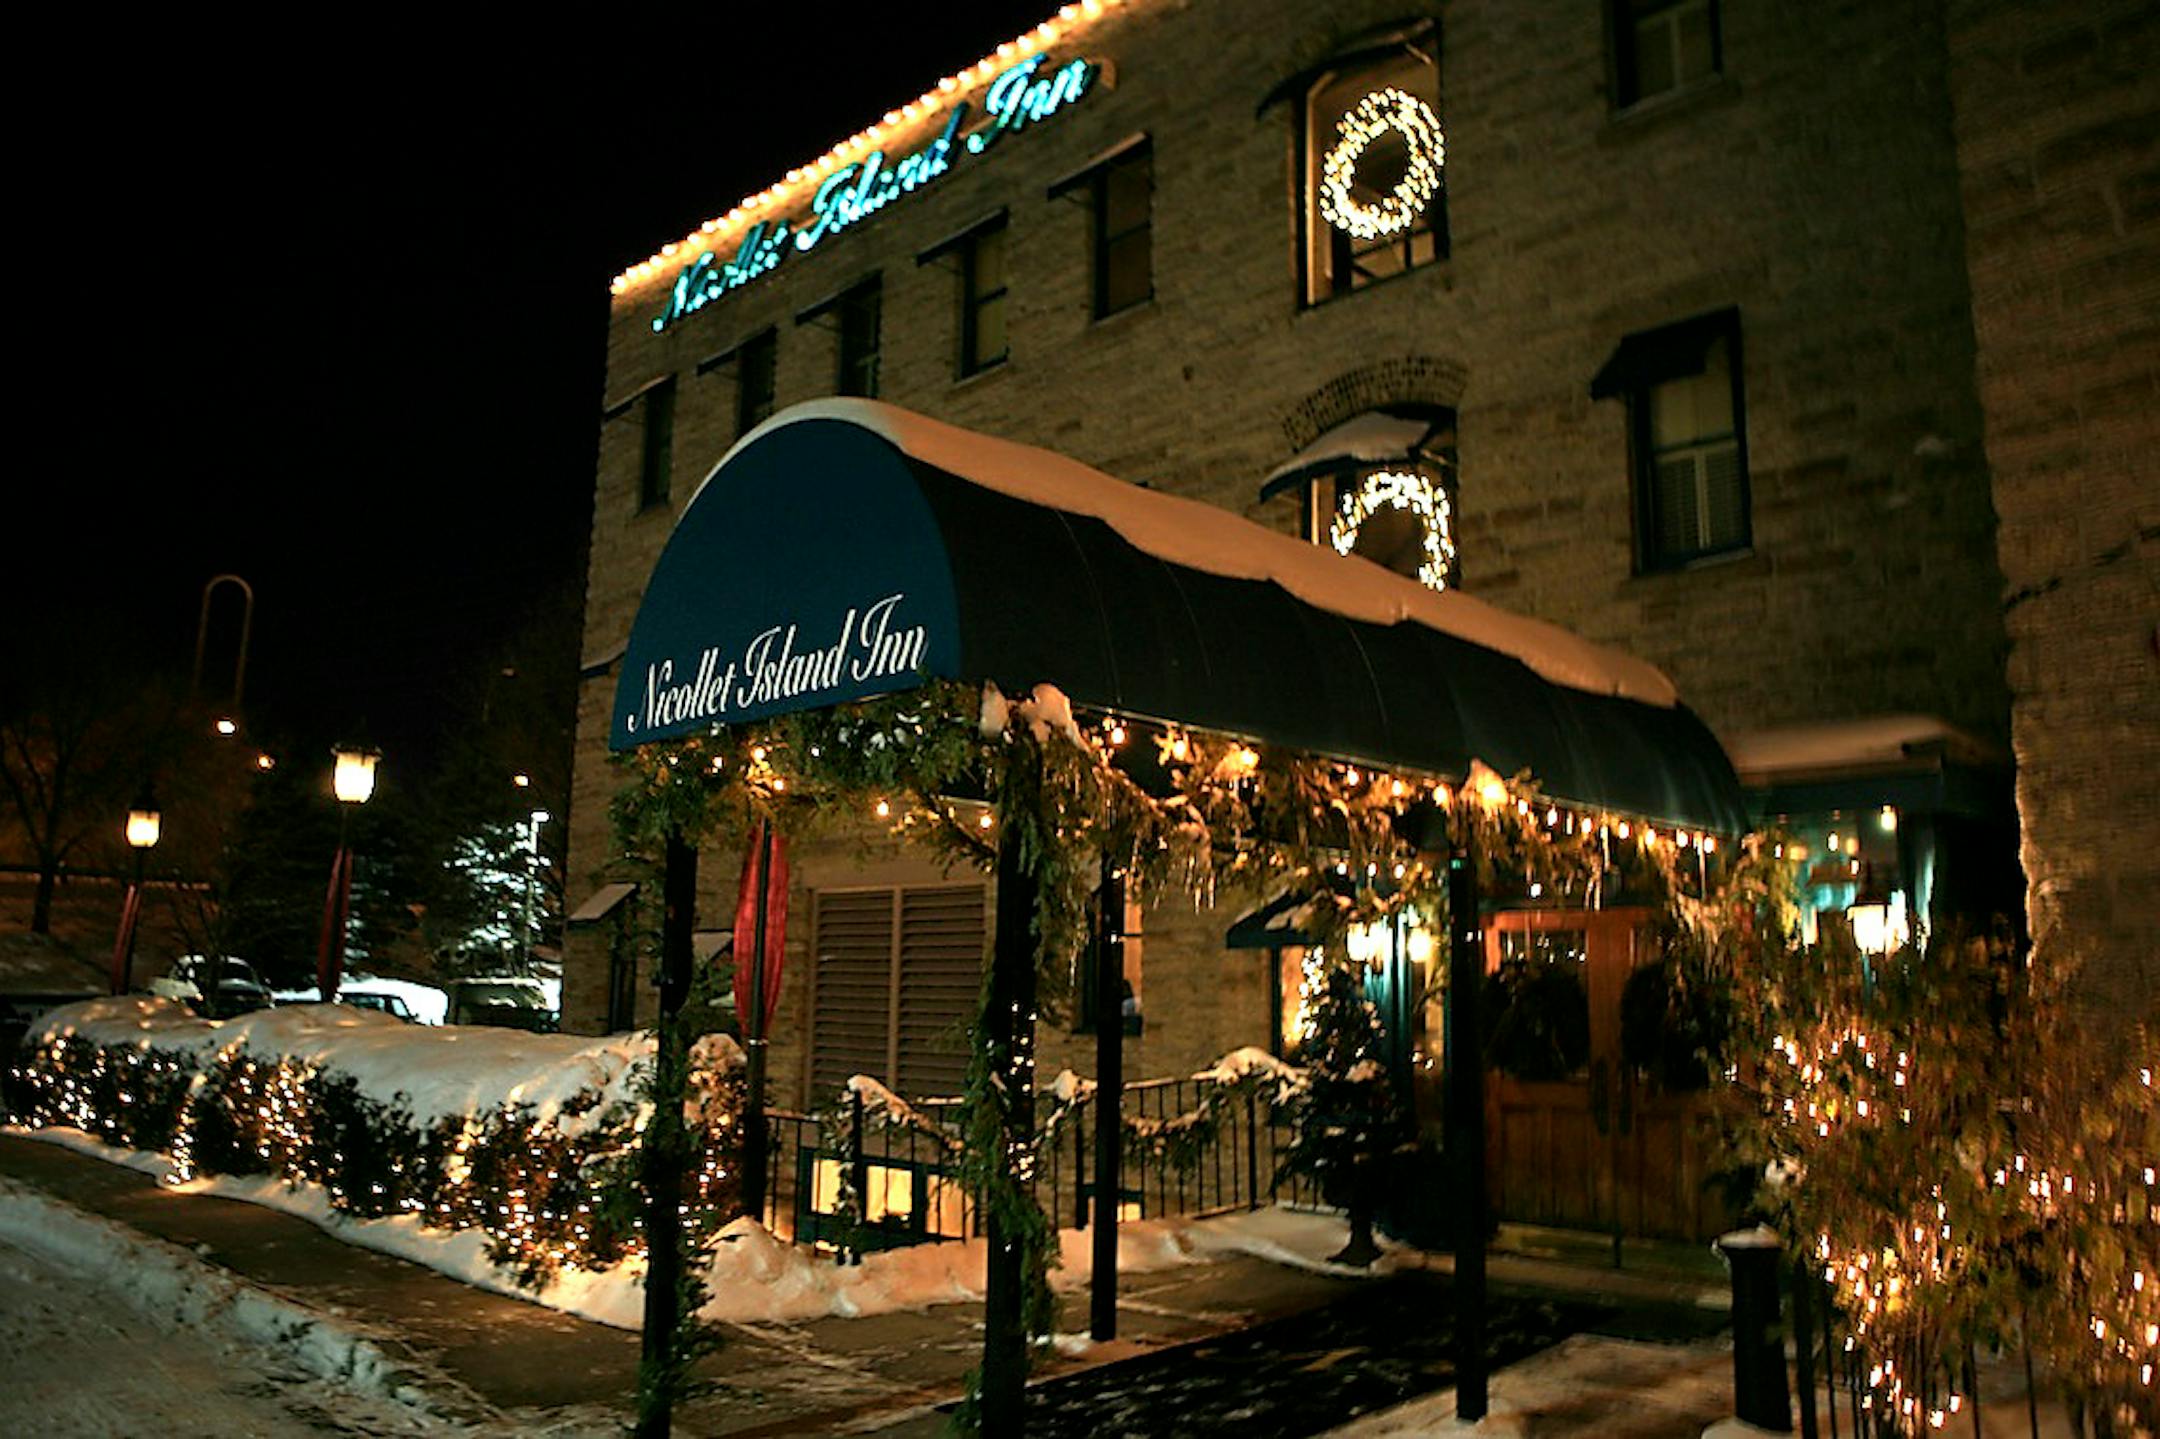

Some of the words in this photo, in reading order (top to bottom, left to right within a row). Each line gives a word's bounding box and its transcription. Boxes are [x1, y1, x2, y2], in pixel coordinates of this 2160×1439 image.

[966, 52, 1098, 154] Inn
[627, 647, 737, 733] Nicollet
[737, 609, 856, 709] Island
[852, 593, 926, 683] Inn
